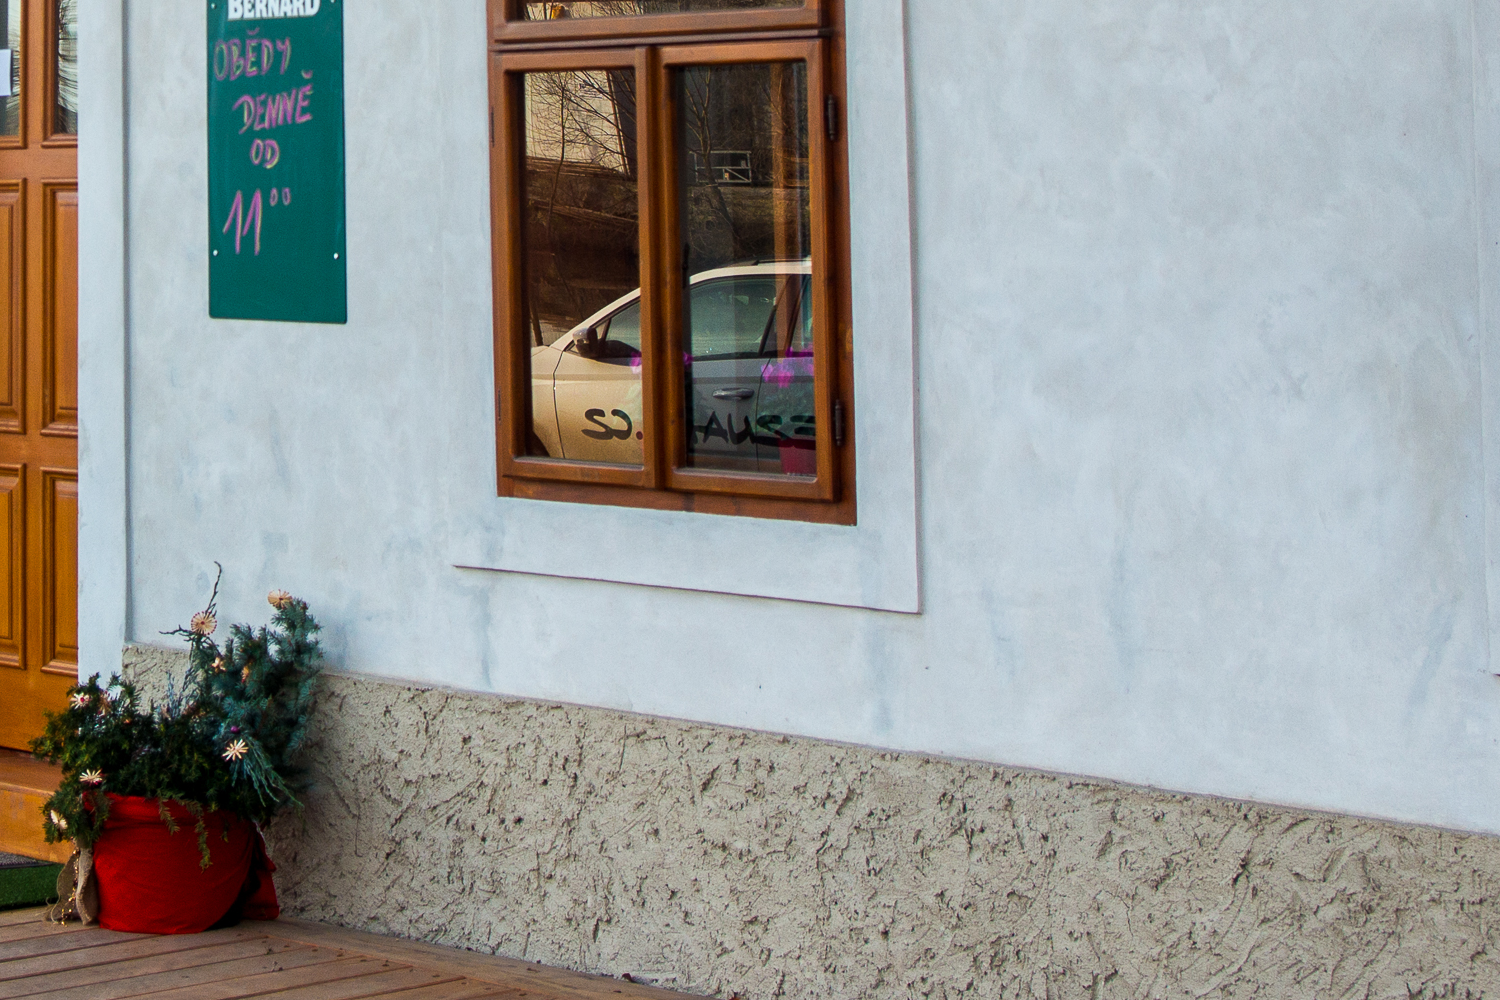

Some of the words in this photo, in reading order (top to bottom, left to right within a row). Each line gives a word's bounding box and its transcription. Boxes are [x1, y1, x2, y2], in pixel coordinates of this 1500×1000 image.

[214, 27, 292, 81] OBĚDY
[232, 70, 313, 134] DENNĚ
[251, 139, 280, 169] OD
